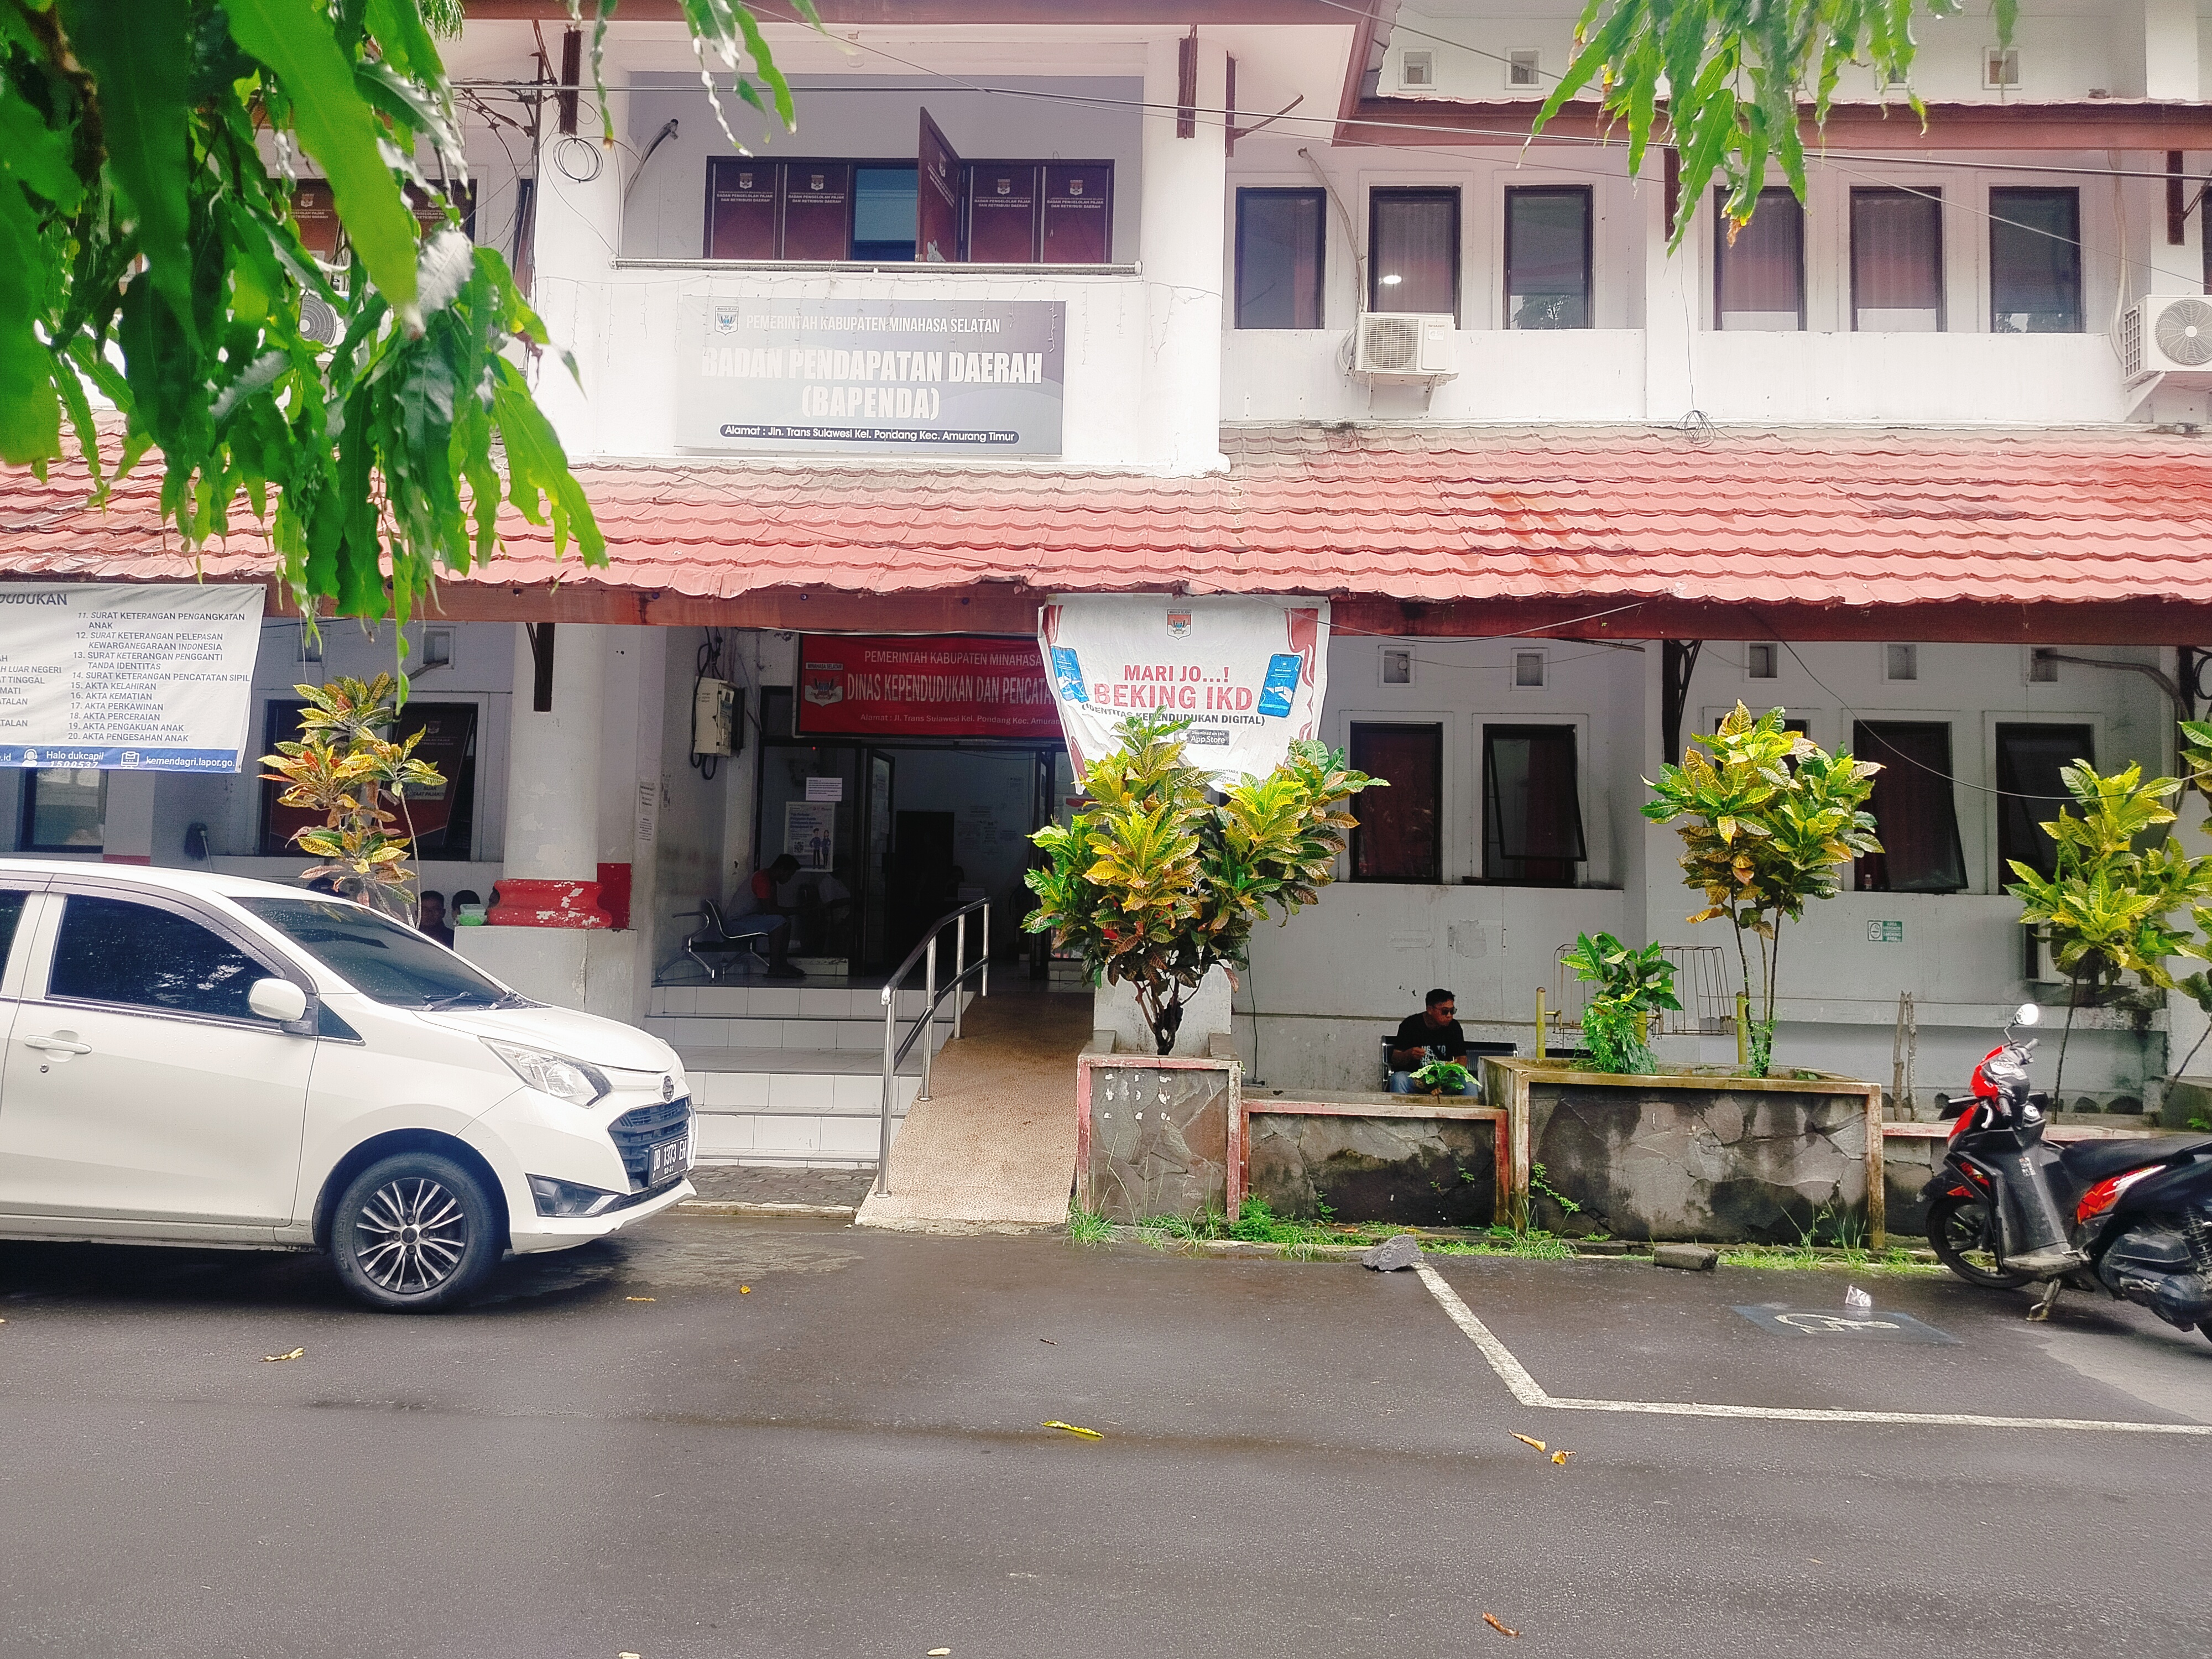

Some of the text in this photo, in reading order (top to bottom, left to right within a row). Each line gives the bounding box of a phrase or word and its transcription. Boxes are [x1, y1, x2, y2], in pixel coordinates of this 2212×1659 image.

[747, 315, 1000, 333] PEMERINTAH KABUPATEN MINAHASA SELATAN
[702, 347, 1042, 383] BADAN PENDAPATAN DAERAH
[802, 385, 940, 420] (BAPENDA)
[725, 425, 760, 436] Alamat
[768, 426, 784, 436] Jln.
[786, 427, 810, 437] Trans
[813, 428, 852, 438] Sulawesi
[855, 429, 872, 439] Kel.
[874, 430, 917, 442] Pondang
[920, 431, 940, 441] Kec.
[942, 432, 986, 443] Amurang
[989, 432, 1014, 441] Timur
[89, 642, 176, 650] KEWARGANEGARAAN
[117, 652, 173, 660] KETERANGAN
[175, 653, 222, 661] PENGGANTI
[865, 651, 927, 664] PEMERINTAH
[930, 652, 987, 665] KABUPATEN
[989, 653, 1042, 666] MINAHASA
[173, 673, 228, 681] PENCATATAN
[1124, 665, 1173, 681] MARI
[847, 674, 1056, 705] DINAS KEPENDUDUKAN DAN PENCATA
[1094, 684, 1253, 711] BEKING IKD
[108, 702, 164, 711] PERKAWINAN
[977, 716, 1011, 726] Pondang
[1222, 714, 1265, 726] DIGITAL)
[107, 723, 158, 731] PENGAKUAN
[165, 734, 189, 742] ANAK
[0, 753, 11, 761] .id
[46, 750, 104, 763] Halo dukcapil
[654, 1140, 686, 1171] DB 1373 EH
